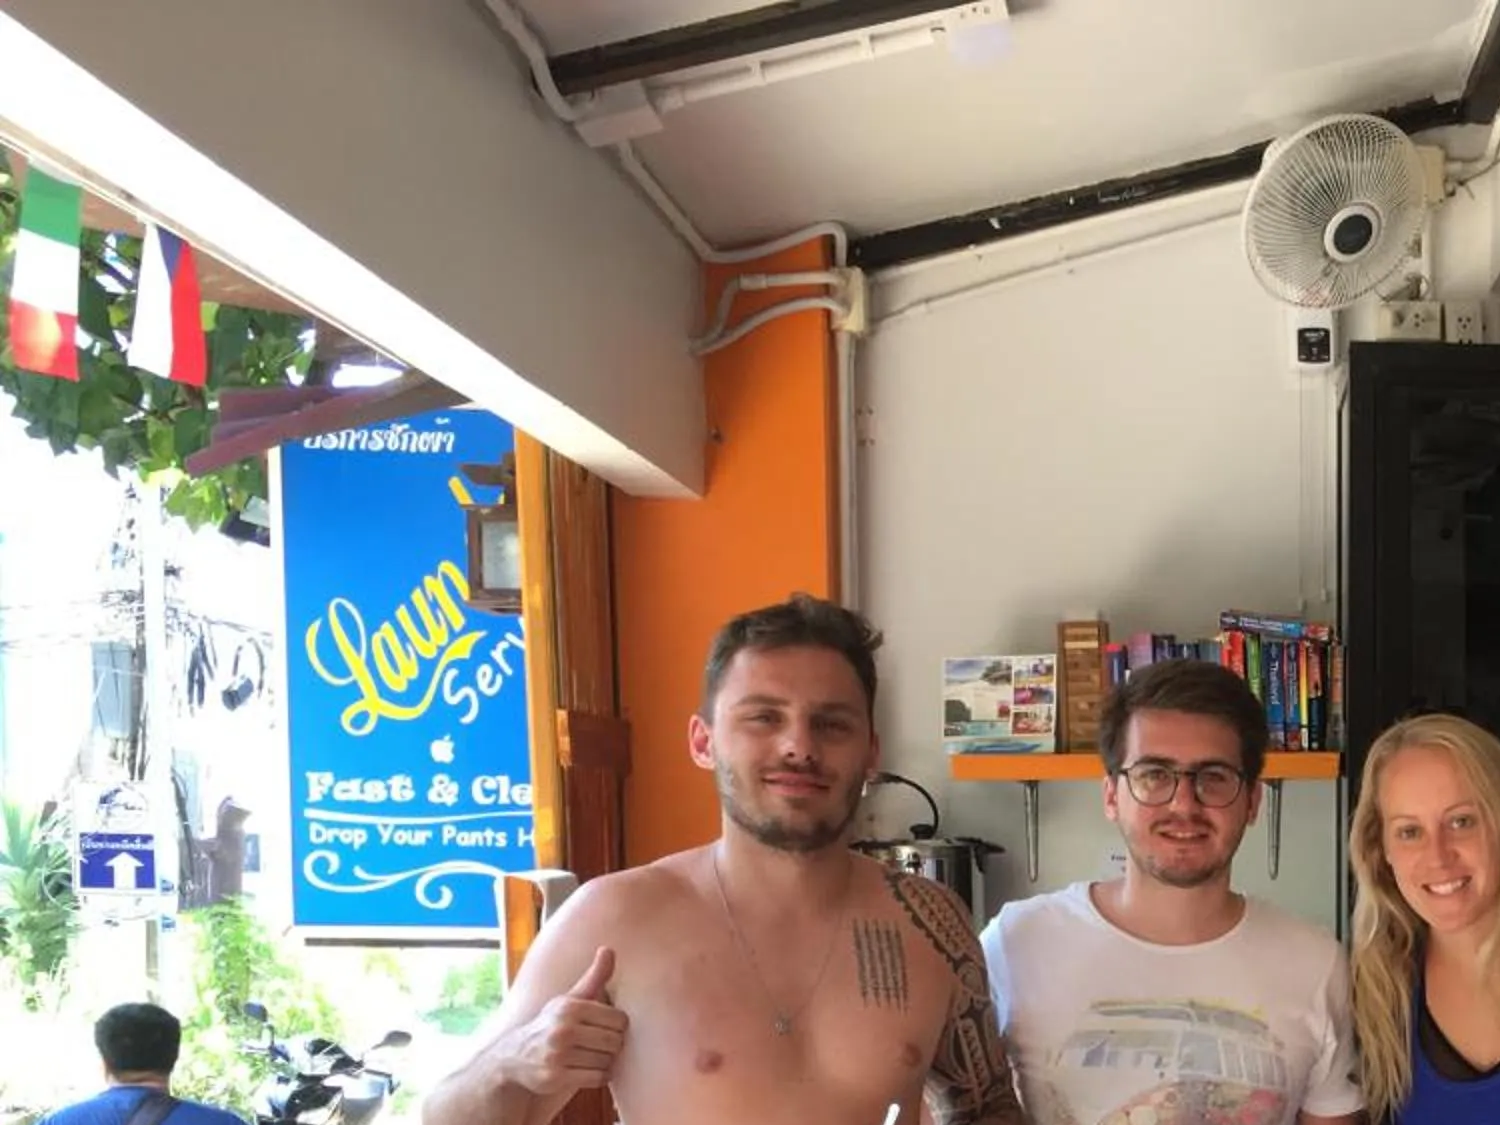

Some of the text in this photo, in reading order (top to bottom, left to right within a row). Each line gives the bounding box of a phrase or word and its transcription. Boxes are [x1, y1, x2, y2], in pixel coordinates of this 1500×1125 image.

[306, 560, 487, 736] Laun
[443, 616, 526, 724] Serv
[306, 771, 532, 805] Fast & Cle
[309, 822, 534, 850] Drop Your Pants H
